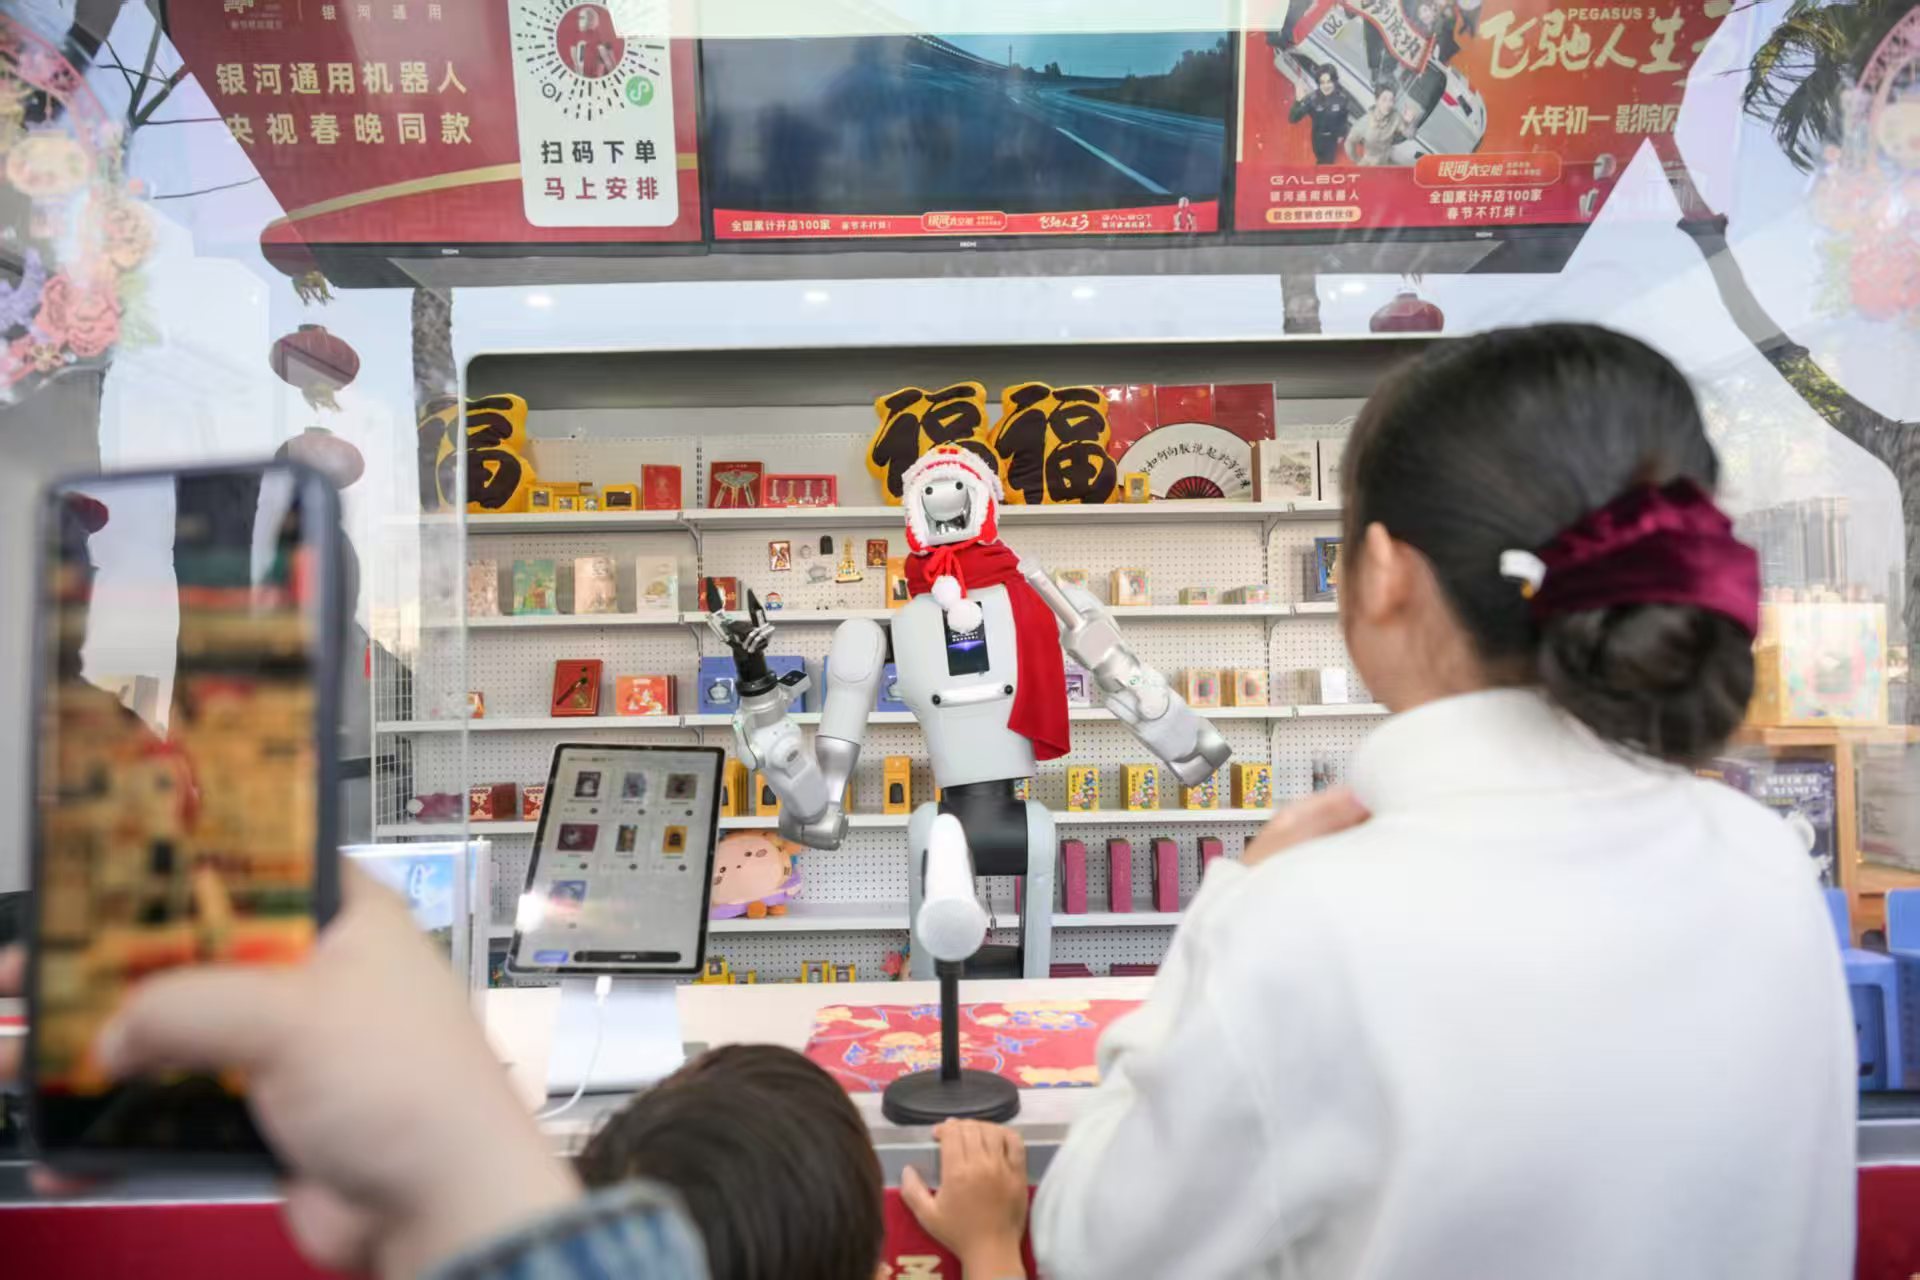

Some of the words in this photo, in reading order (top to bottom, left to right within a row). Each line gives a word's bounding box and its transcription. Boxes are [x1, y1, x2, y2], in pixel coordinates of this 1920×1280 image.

[1567, 7, 1642, 21] PEGASUS
[1647, 7, 1656, 20] 3
[1478, 7, 1708, 80] 飞驰人生
[215, 62, 468, 96] 银河通用机器人
[225, 112, 473, 146] 央视春晚同款
[1520, 105, 1611, 136] 大年初一
[540, 139, 658, 164] 扫码下单
[544, 176, 659, 201] 马上安排
[1269, 173, 1361, 186] GALBOT
[1429, 188, 1543, 204] 全国累计开店100家
[731, 219, 831, 232] 全国累计开店100家
[996, 386, 1118, 505] 福
